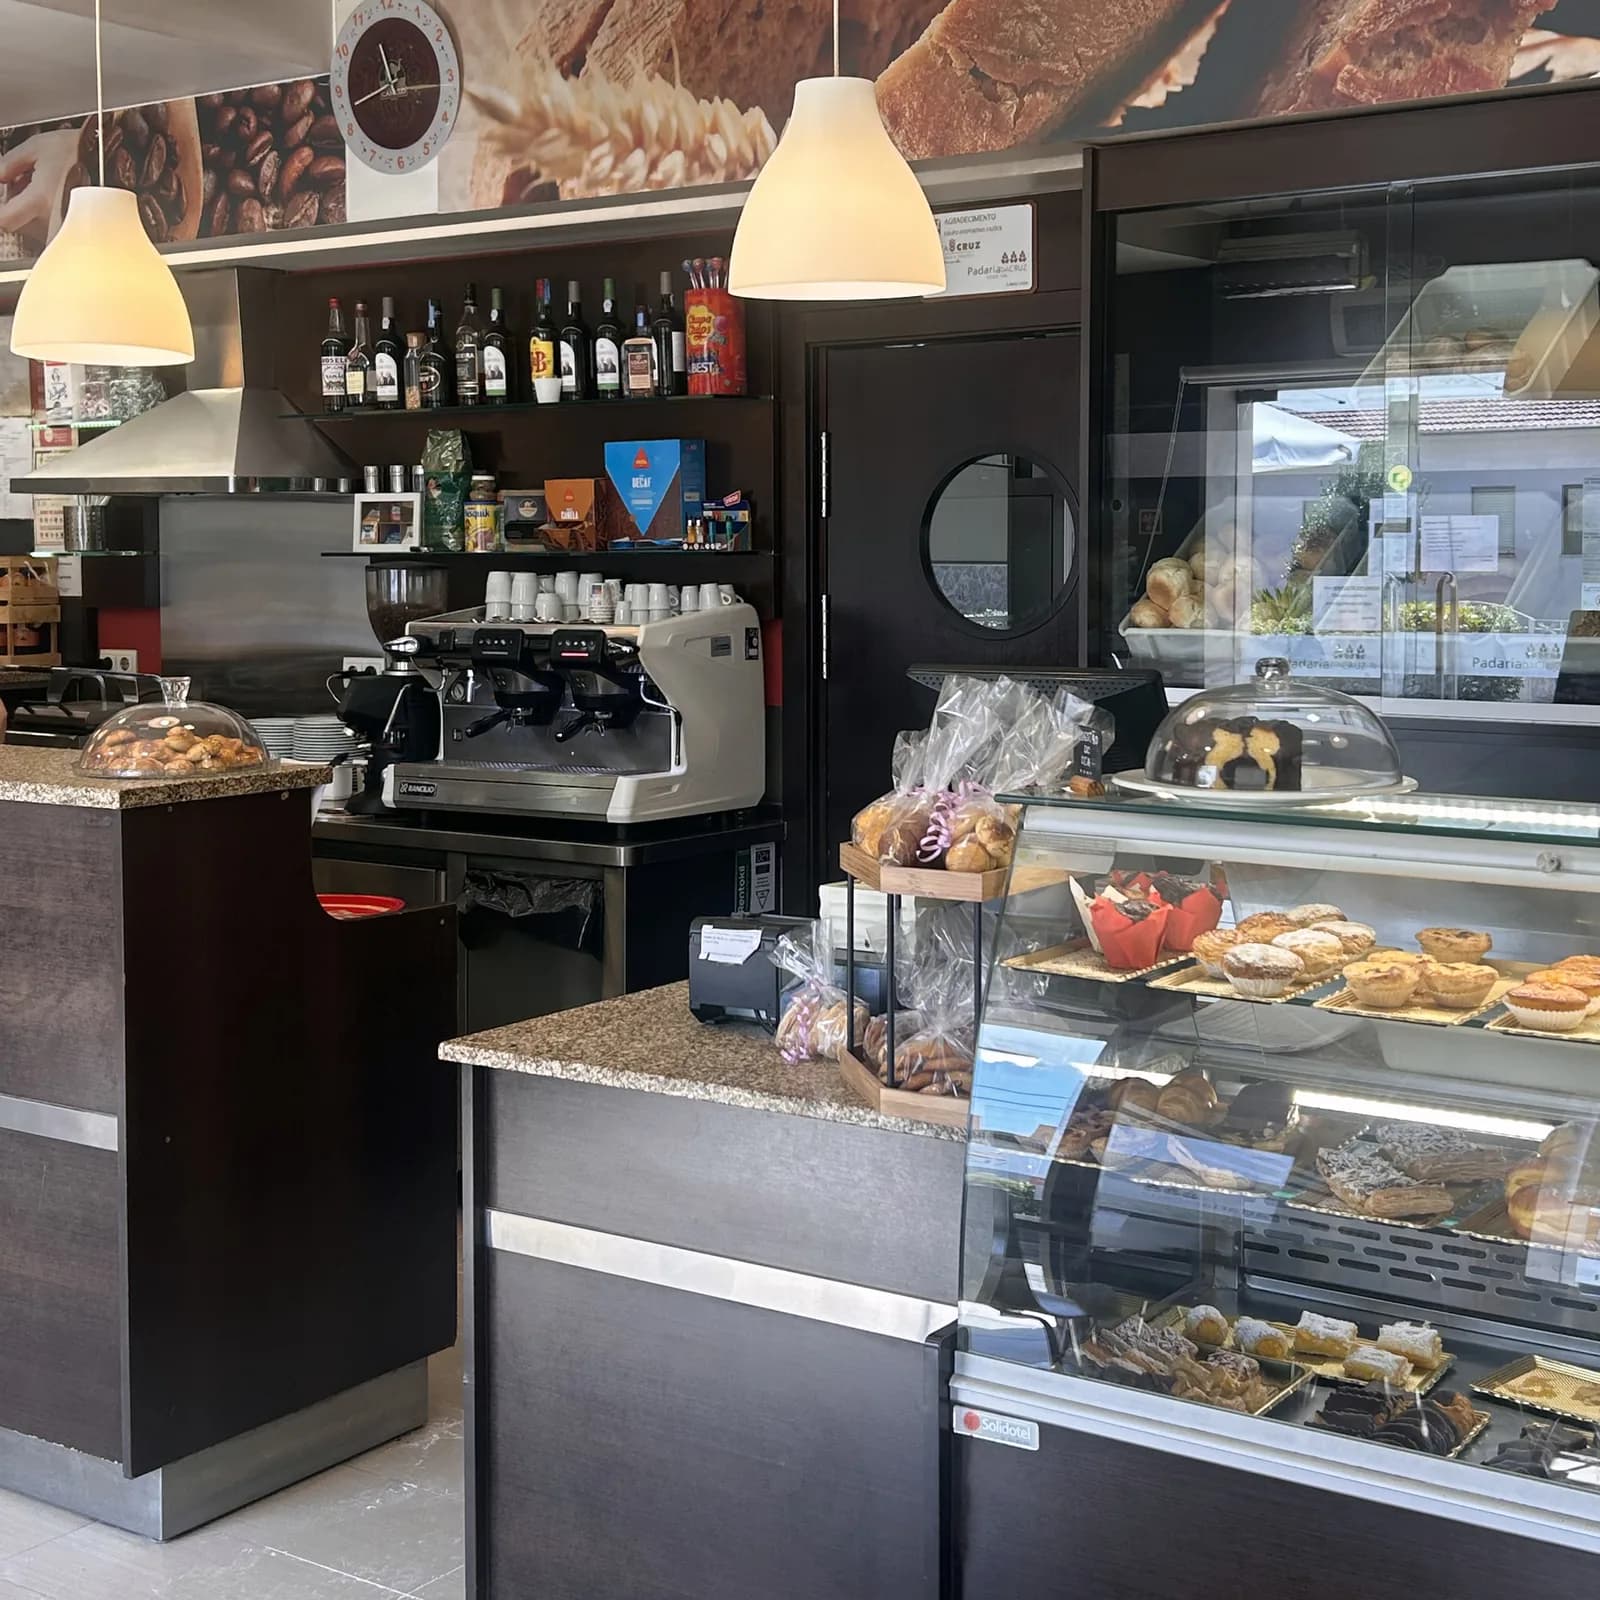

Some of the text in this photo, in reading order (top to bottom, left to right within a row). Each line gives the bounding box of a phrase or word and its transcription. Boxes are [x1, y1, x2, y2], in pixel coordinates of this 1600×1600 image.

[352, 14, 364, 25] 11
[414, 7, 421, 19] 1
[434, 28, 443, 42] 2
[336, 44, 349, 57] 10
[446, 69, 454, 82] 3
[335, 85, 343, 98] 9
[441, 111, 449, 123] 4
[346, 123, 354, 137] 8
[368, 149, 377, 162] 7
[422, 142, 430, 156] 5
[397, 156, 405, 169] 6
[945, 213, 997, 225] AGRADECIMENTO
[956, 241, 981, 251] CRUZ
[967, 265, 1001, 276] Padaria
[692, 361, 715, 373] BEST
[632, 476, 652, 489] DECAF
[1472, 656, 1522, 670] Padaria
[982, 1419, 1031, 1440] Solidotel
